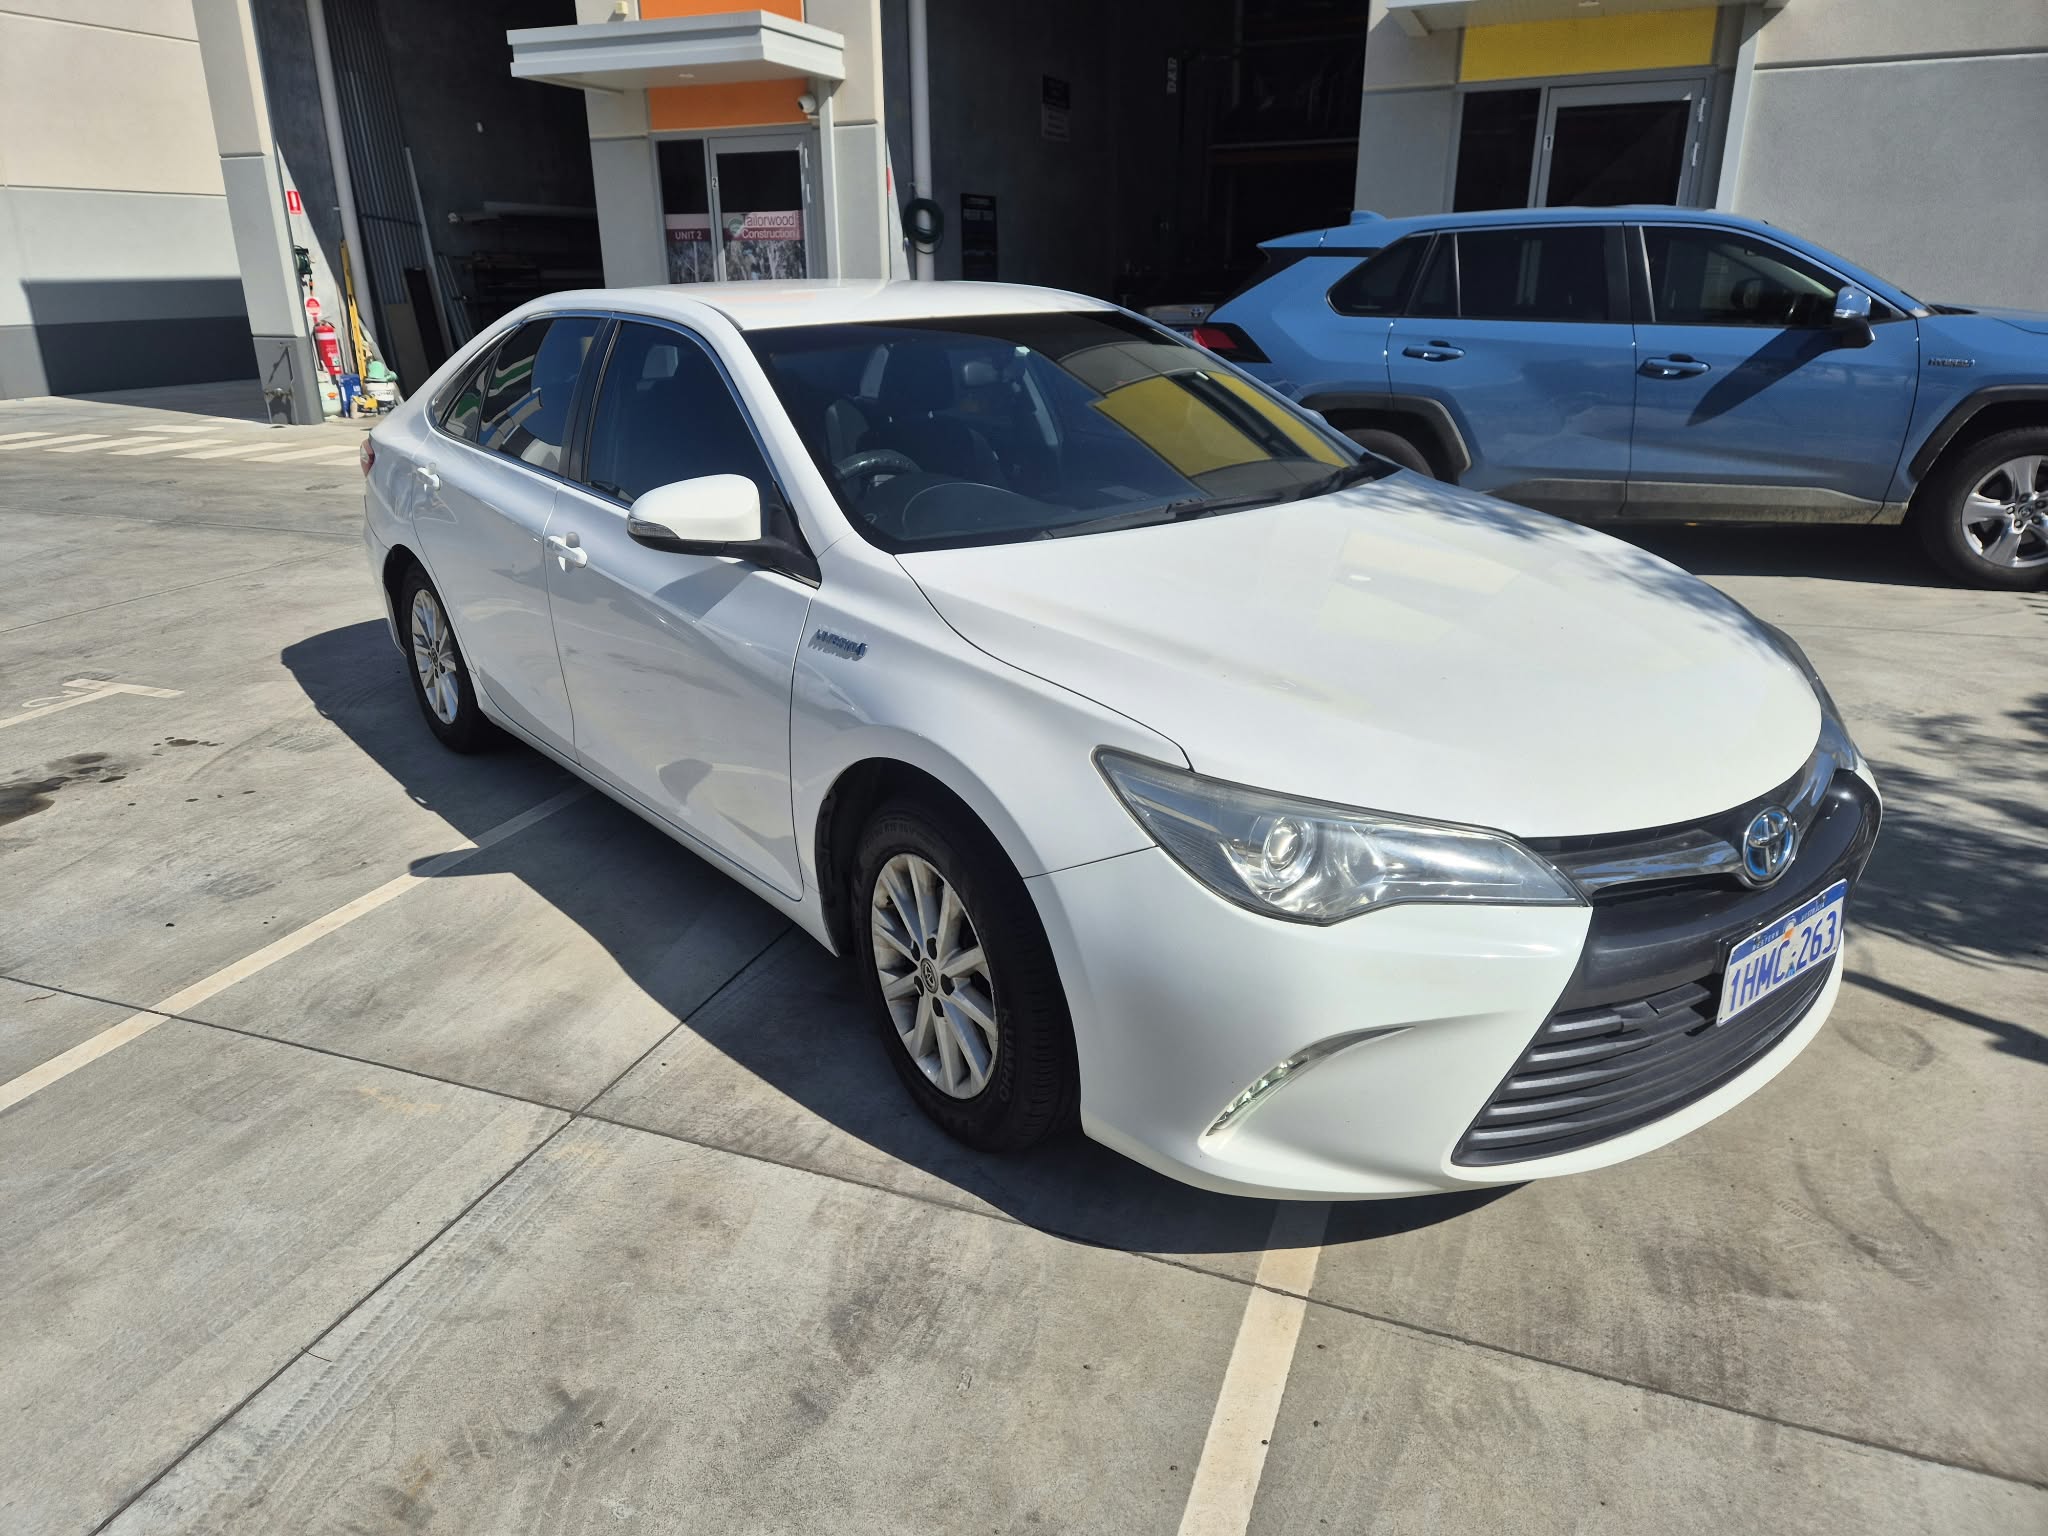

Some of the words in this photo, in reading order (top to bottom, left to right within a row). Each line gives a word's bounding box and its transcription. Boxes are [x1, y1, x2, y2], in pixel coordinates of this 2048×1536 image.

[741, 213, 795, 226] Tailorwood
[674, 230, 695, 240] UNIT
[696, 230, 703, 240] 2
[742, 229, 796, 239] Construction
